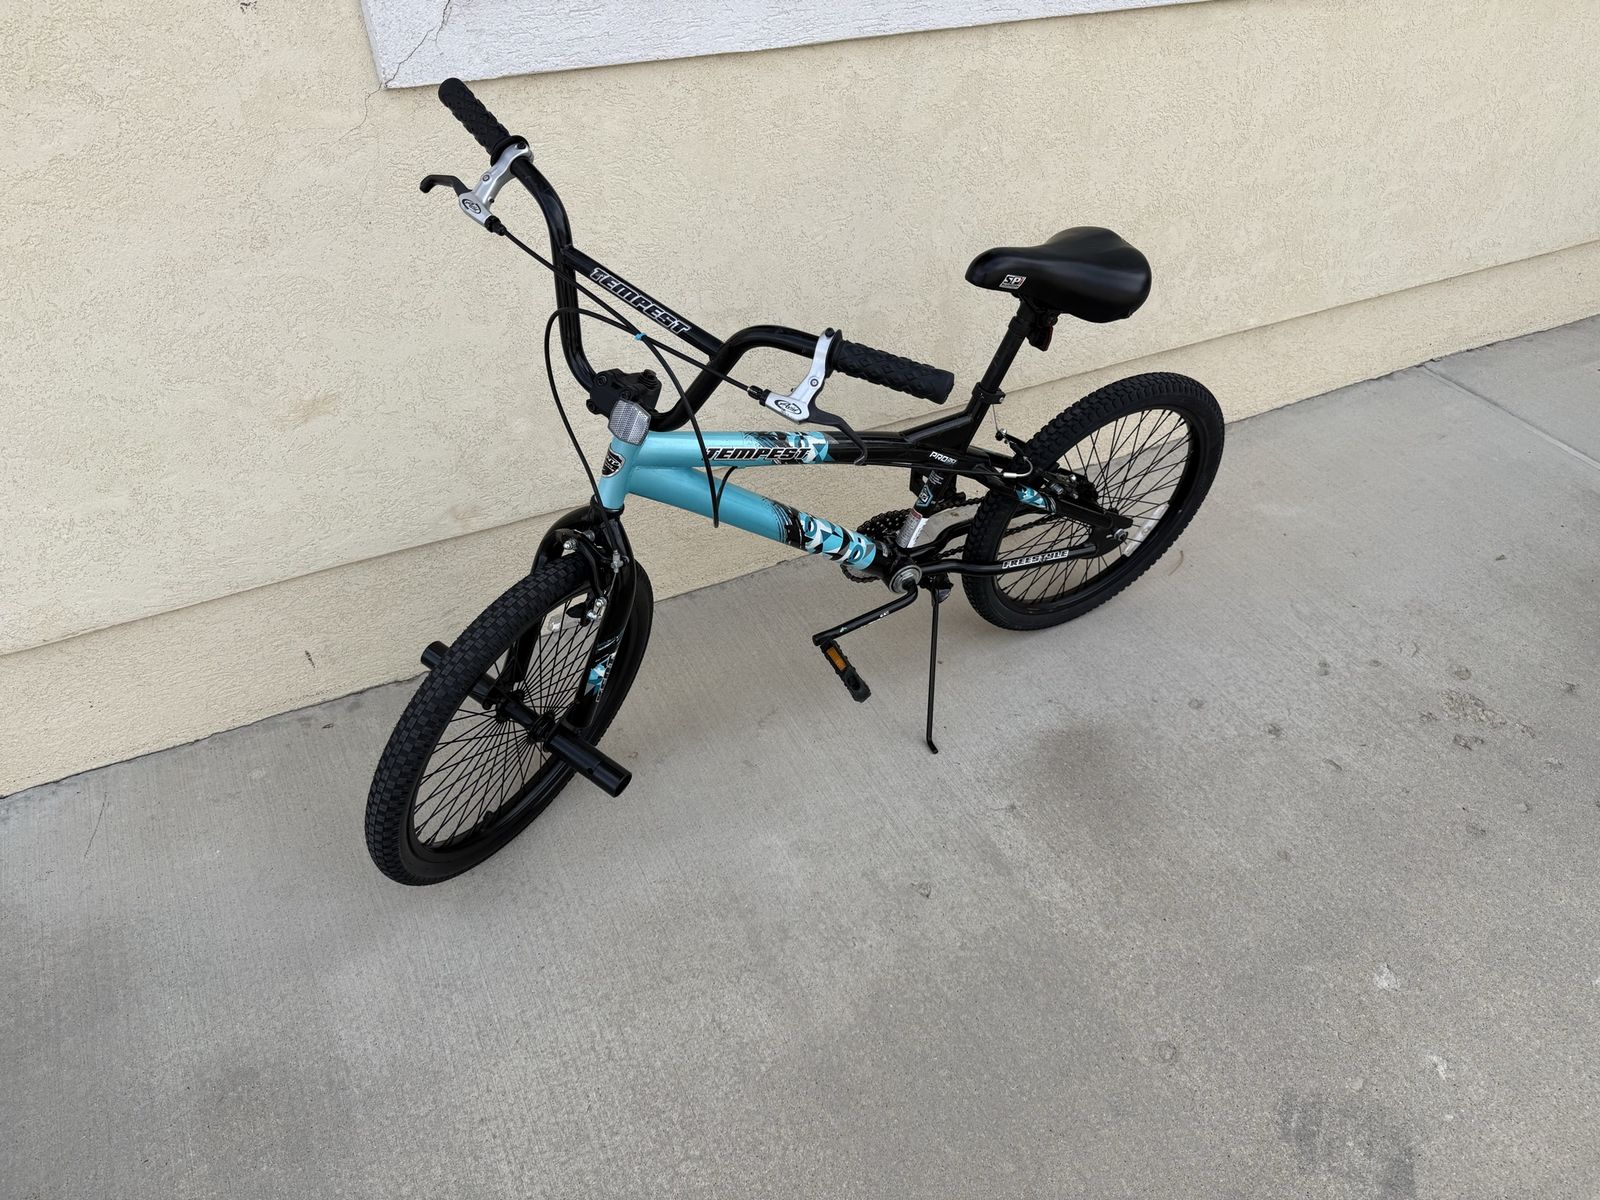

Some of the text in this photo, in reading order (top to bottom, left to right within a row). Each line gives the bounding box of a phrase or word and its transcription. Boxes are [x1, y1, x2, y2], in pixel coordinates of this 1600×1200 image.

[590, 267, 692, 335] TEMPEST
[704, 447, 811, 461] TEMPEST
[1001, 550, 1070, 570] FREESTYLE
